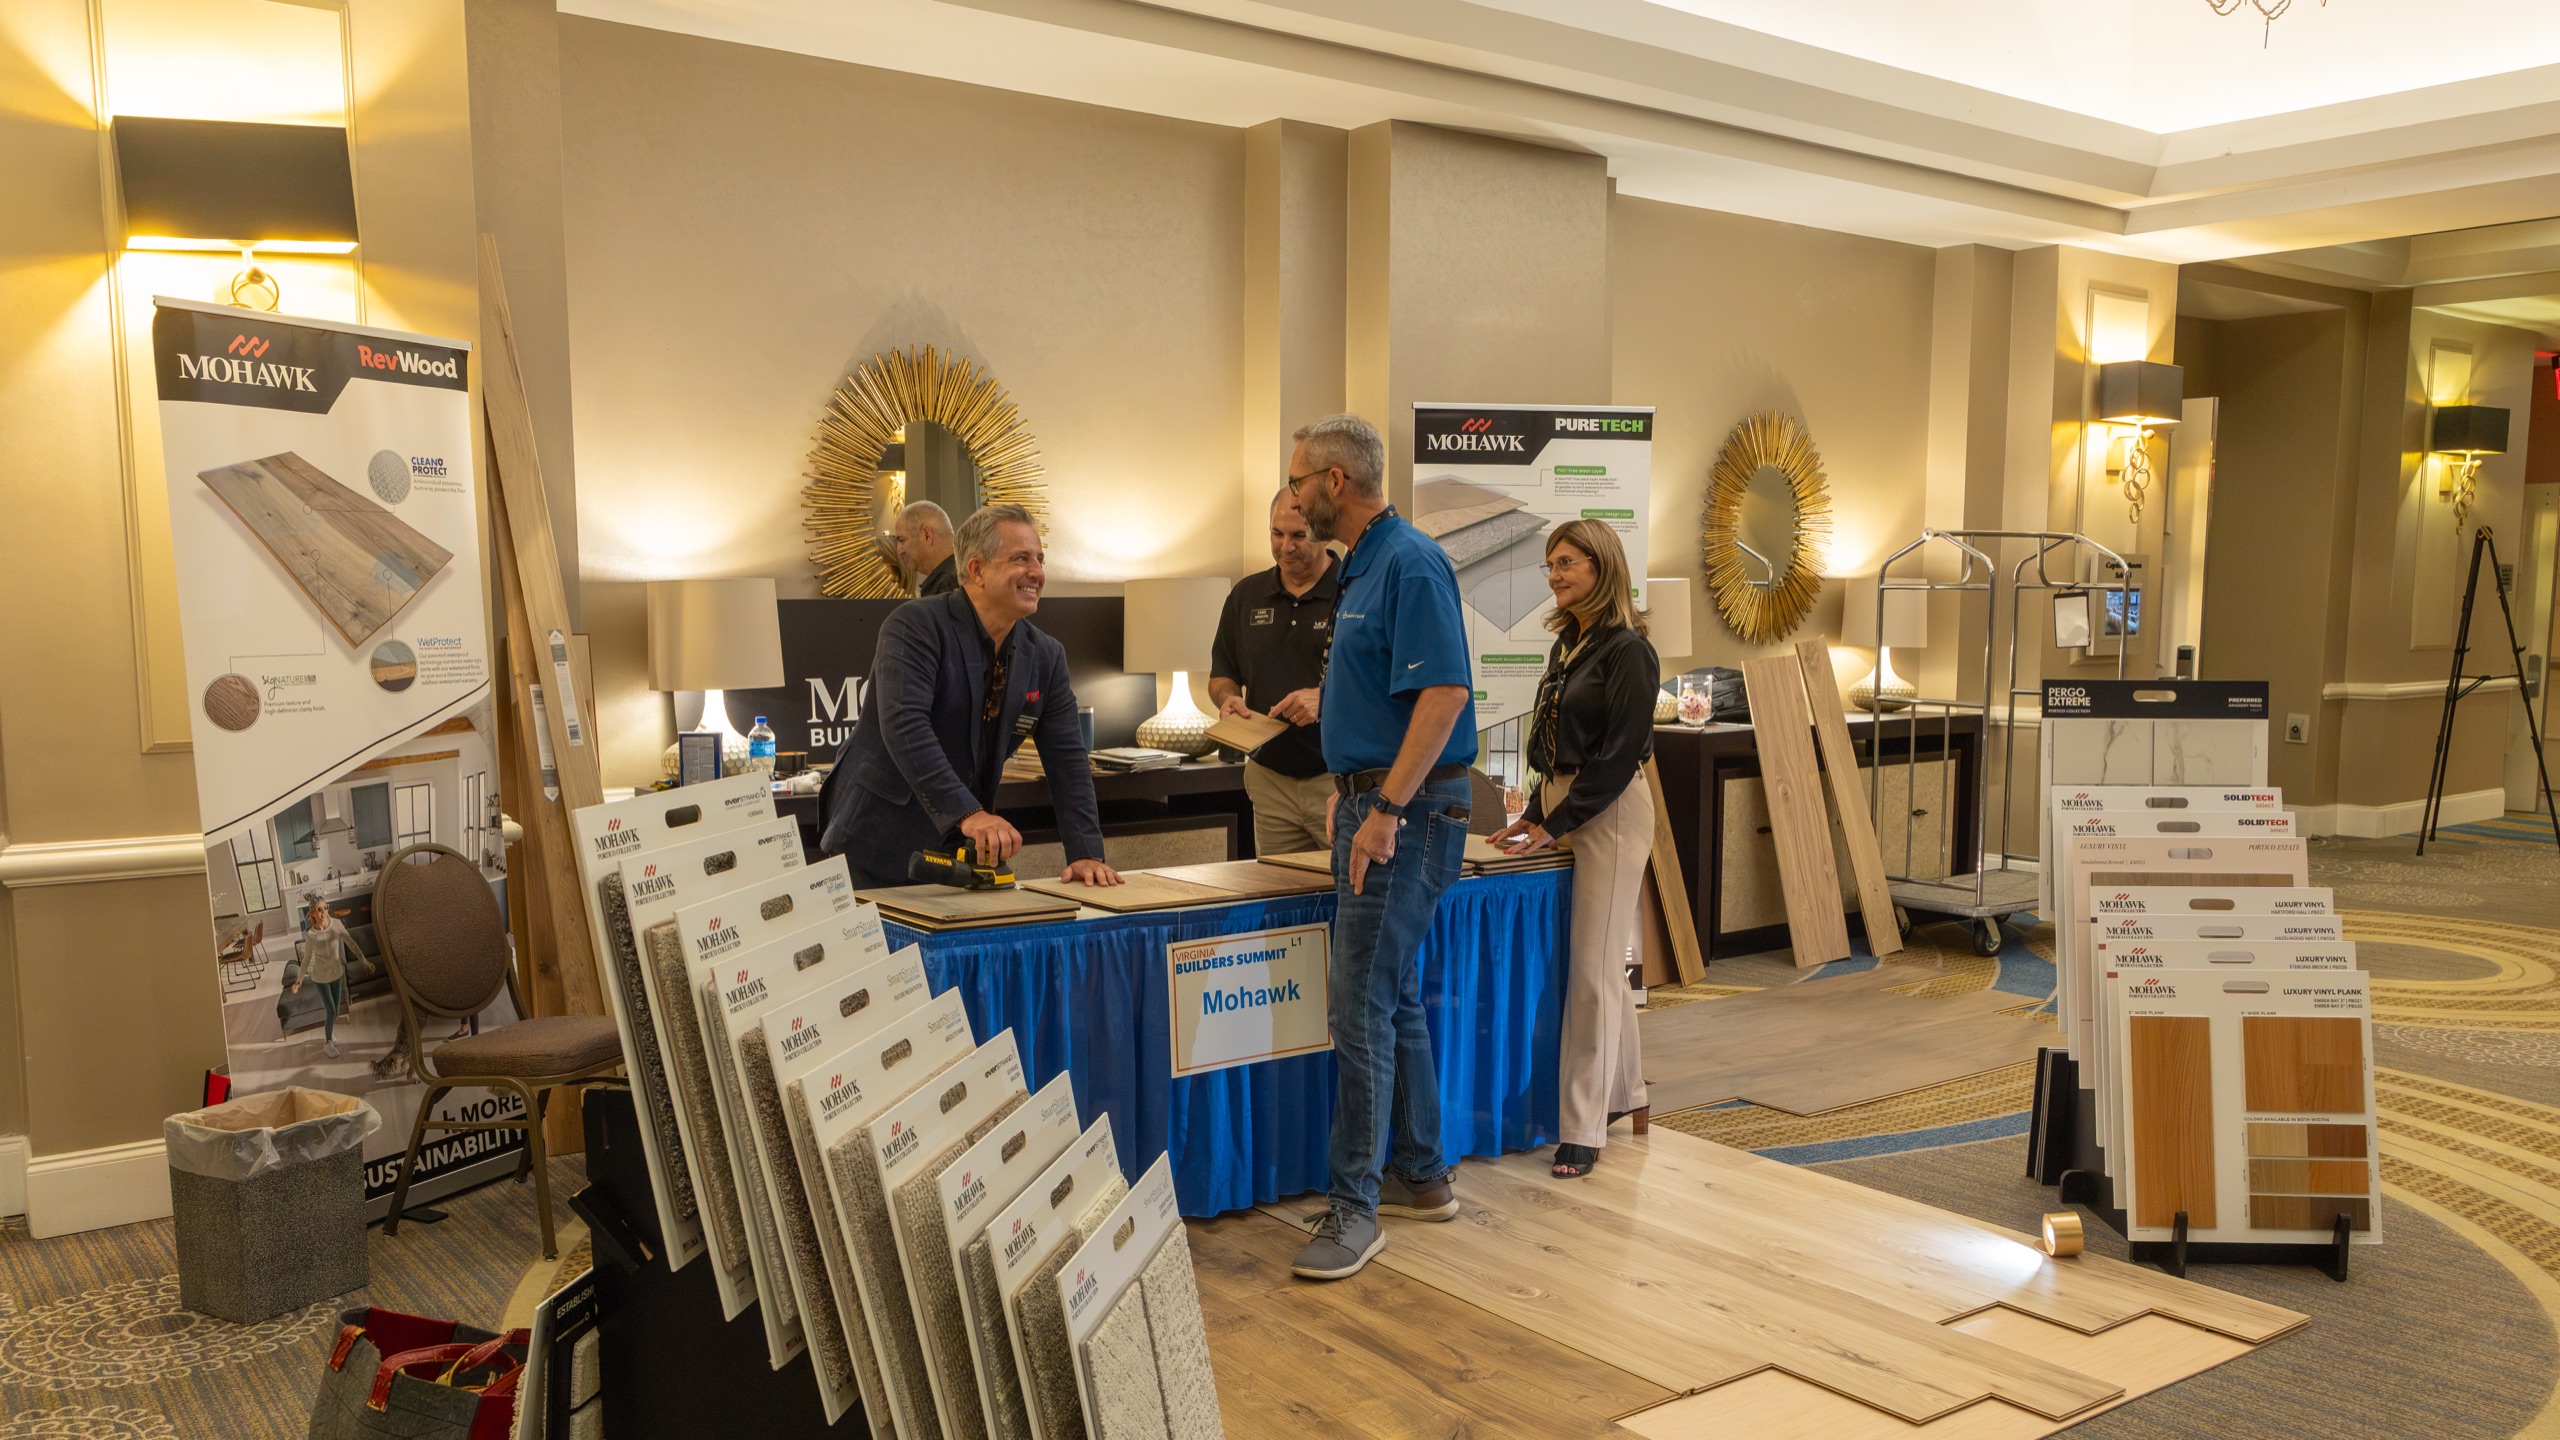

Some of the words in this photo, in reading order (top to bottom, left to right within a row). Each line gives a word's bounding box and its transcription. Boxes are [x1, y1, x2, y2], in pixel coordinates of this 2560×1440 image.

[177, 353, 318, 392] MOHAWK
[357, 345, 458, 379] RevWood
[1555, 418, 1644, 433] PURETECH
[1427, 434, 1525, 452] MOHAWK
[412, 465, 447, 476] PROTECT
[417, 637, 462, 647] WetProtect
[805, 676, 869, 723] M
[2048, 687, 2086, 697] PERGO
[2048, 697, 2091, 706] EXTREME
[810, 726, 854, 747] BUI
[2061, 799, 2103, 807] MOHAWK
[594, 828, 640, 852] MOHAWK
[2072, 825, 2116, 833] MOHAWK
[632, 873, 675, 899] MOHAWK
[2099, 900, 2146, 909] MOHAWK
[696, 925, 740, 954] MOHAWK
[1291, 936, 1302, 947] L1
[2106, 927, 2153, 935] MOHAWK
[1175, 948, 1216, 962] VIRGINIA
[1175, 955, 1234, 975] BUILDERS
[1237, 948, 1287, 965] SUMMIT
[2115, 955, 2163, 963] MOHAWK
[725, 977, 767, 1007] MOHAWK
[1203, 979, 1301, 1015] Mohawk
[2129, 986, 2176, 994] MOHAWK
[780, 1023, 820, 1055] MOHAWK
[461, 1095, 523, 1122] MORE
[820, 1078, 861, 1115] MOHAWK
[882, 1125, 918, 1163] MOHAWK
[954, 1175, 986, 1215] MOHAWK
[1004, 1221, 1036, 1263] MOHAWK
[1069, 1271, 1098, 1314] MOHAWK
